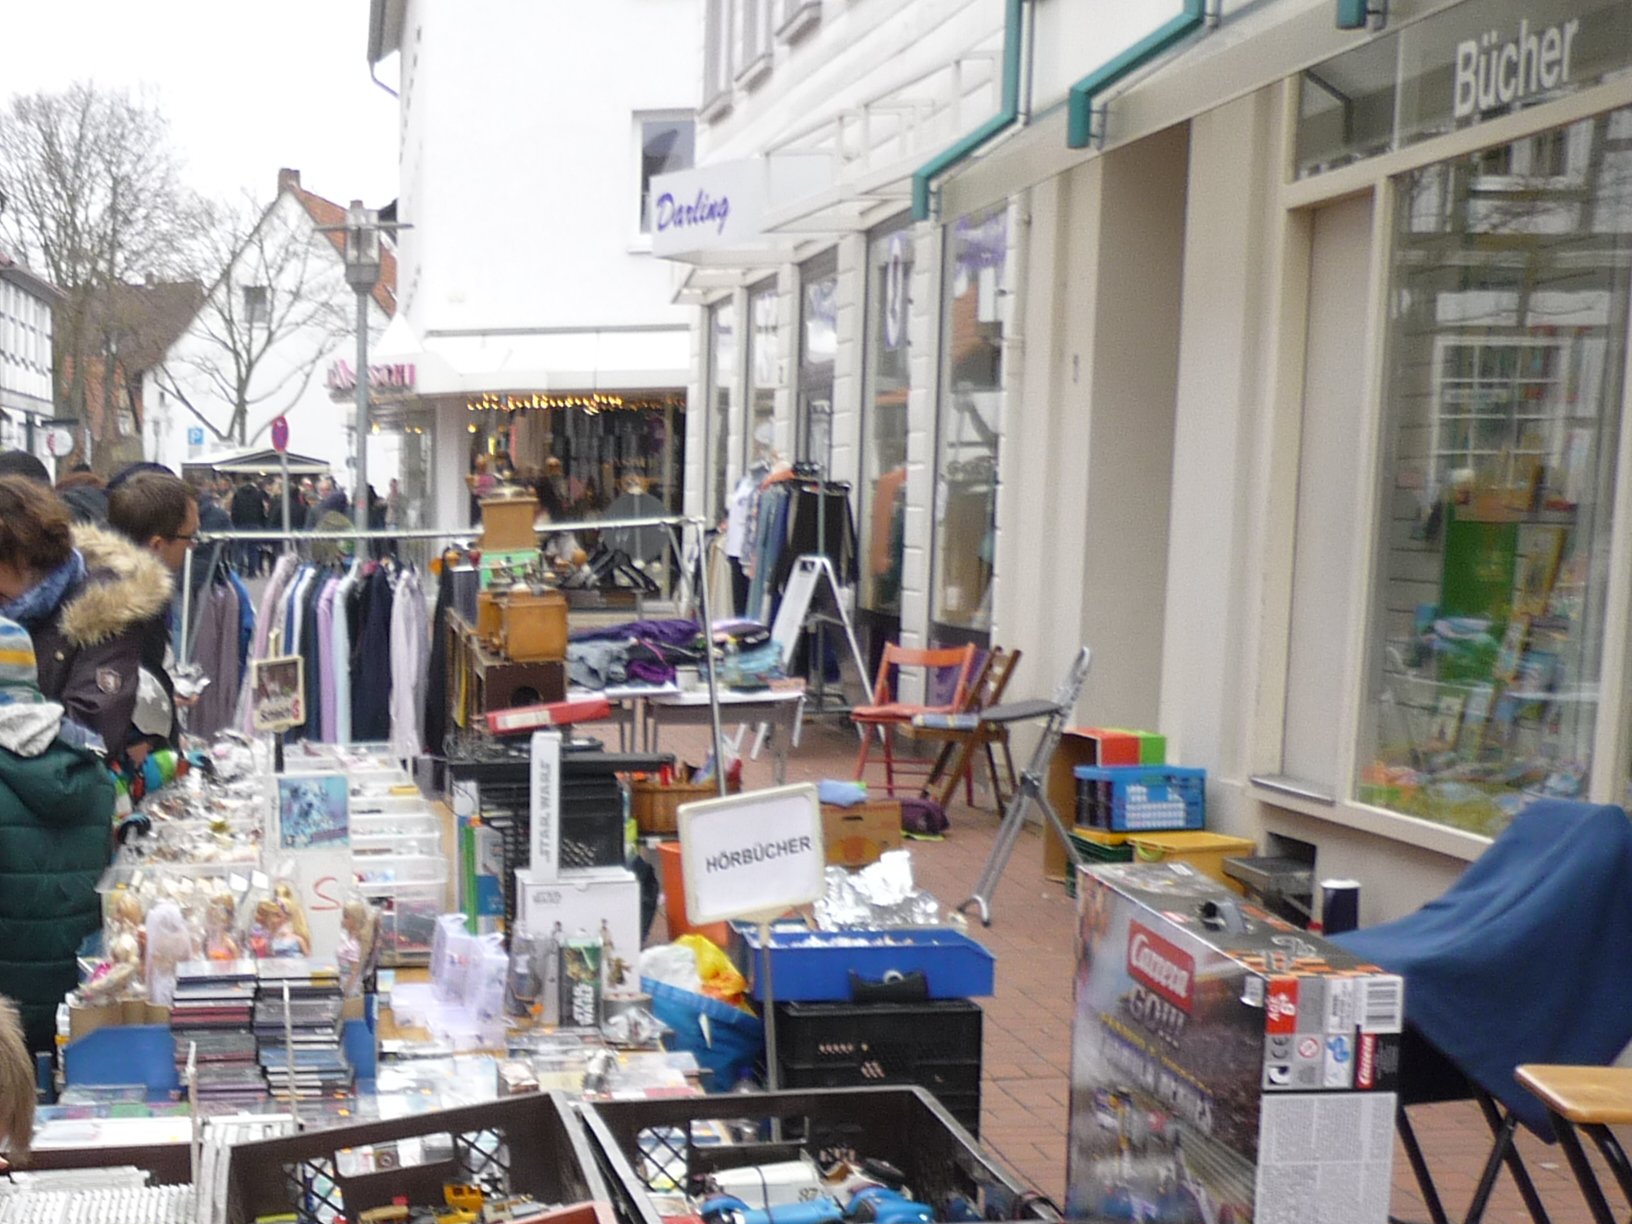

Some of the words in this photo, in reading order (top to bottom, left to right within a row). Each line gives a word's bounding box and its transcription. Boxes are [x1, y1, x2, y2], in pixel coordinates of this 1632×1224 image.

[1454, 18, 1580, 118] Bücher
[656, 187, 730, 235] Darling
[705, 836, 812, 873] HÖRBÜCHER
